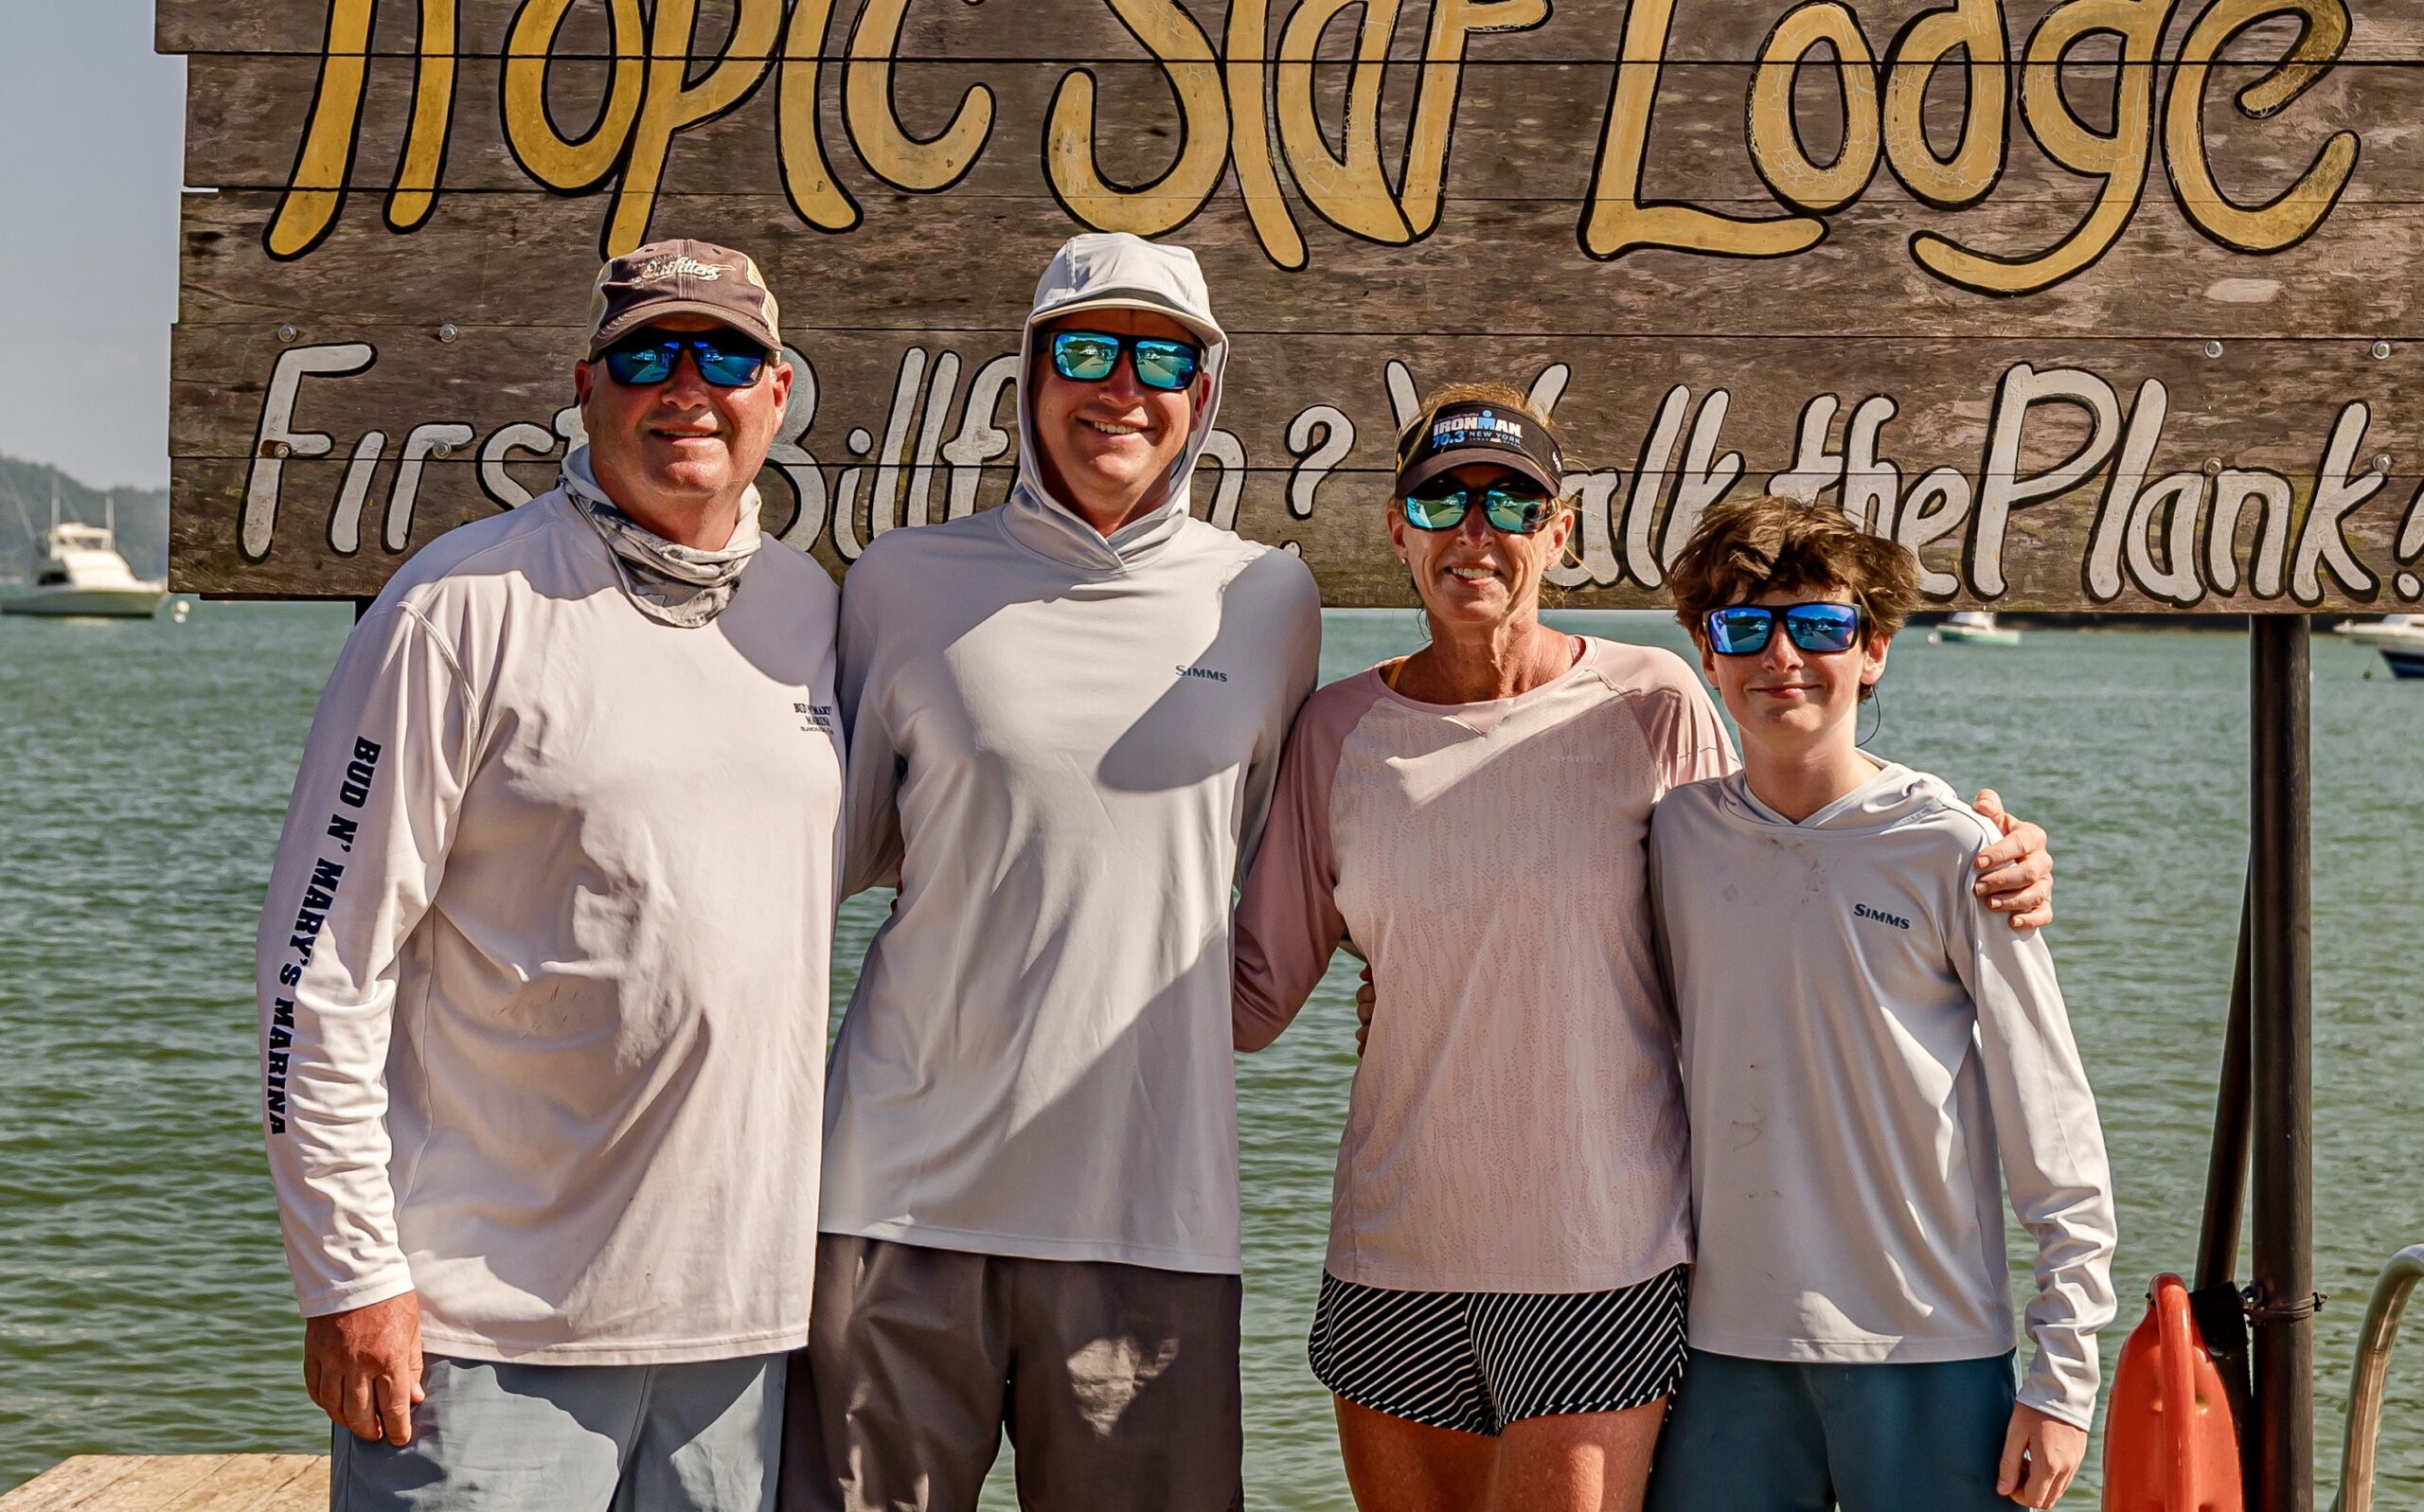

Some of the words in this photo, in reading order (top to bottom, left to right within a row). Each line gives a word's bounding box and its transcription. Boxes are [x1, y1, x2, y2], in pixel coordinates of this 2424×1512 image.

[1577, 0, 2362, 296] Lodge
[1433, 409, 1523, 438] IRONMAN
[1433, 431, 1466, 449] 70.3
[1496, 433, 1521, 445] YORK
[239, 341, 589, 563] Firs
[1764, 392, 1971, 603] the
[1175, 665, 1228, 684] SIMMS
[339, 736, 383, 809] BUD
[278, 857, 346, 988] MARY'S
[1853, 902, 1911, 930] SIMMS
[267, 996, 295, 1135] MARINA
